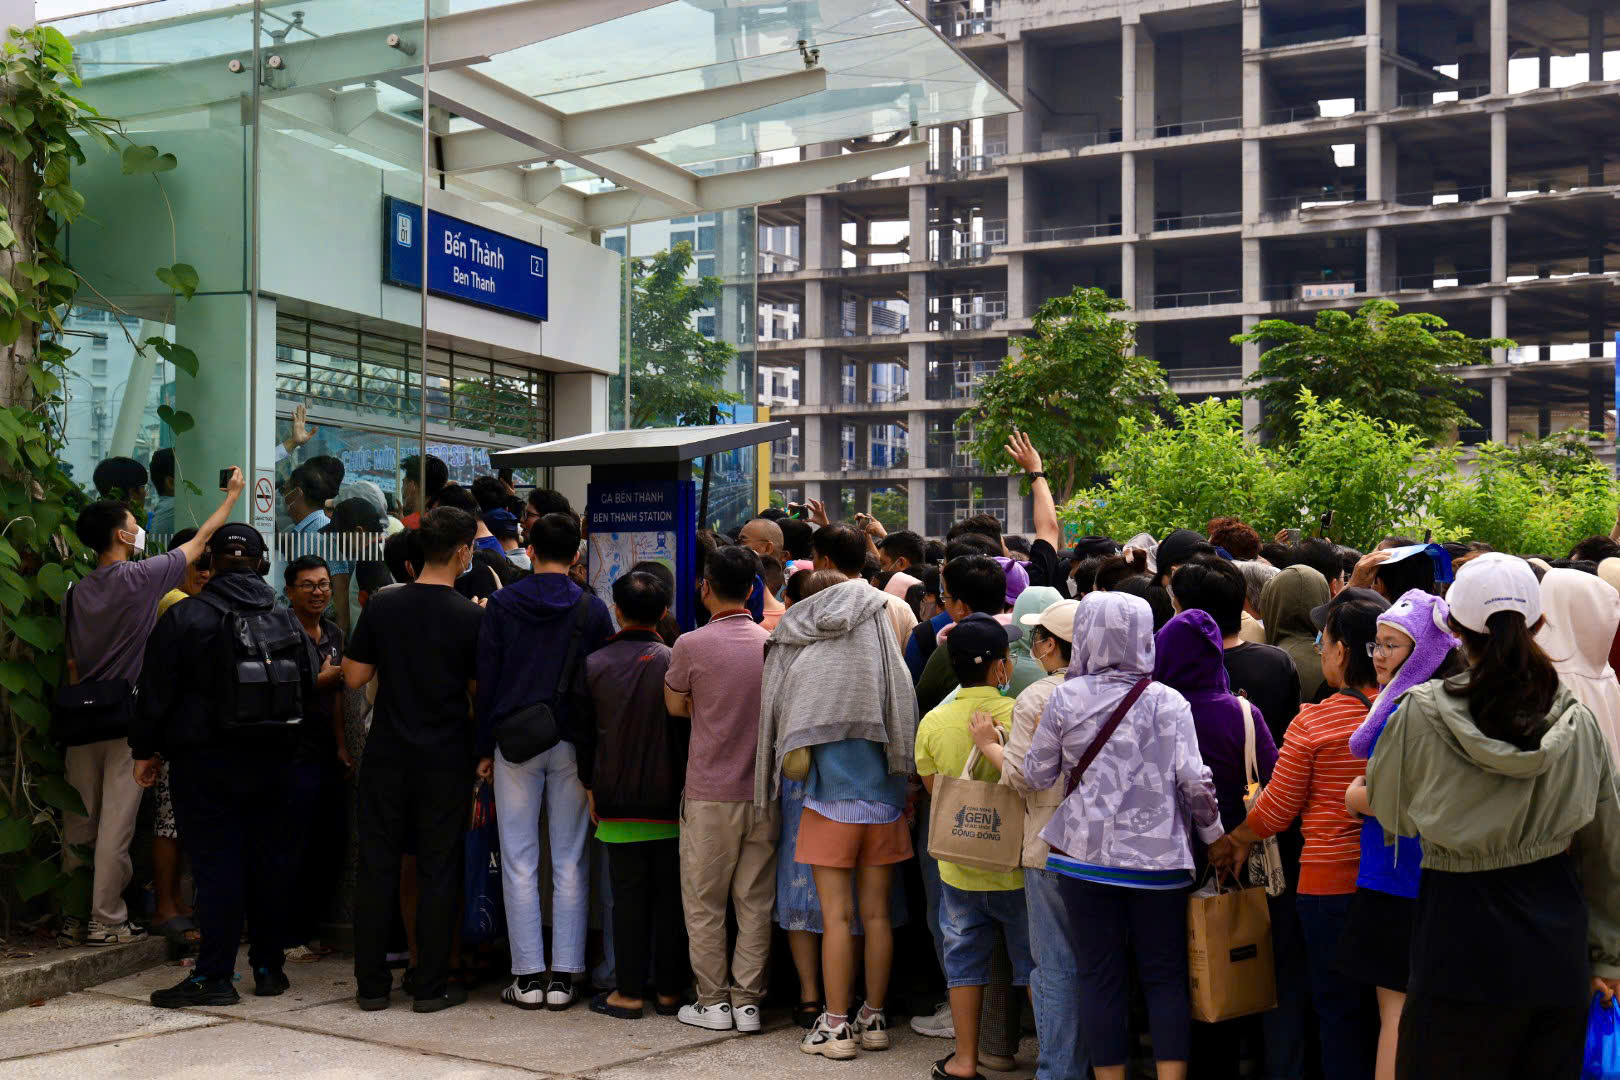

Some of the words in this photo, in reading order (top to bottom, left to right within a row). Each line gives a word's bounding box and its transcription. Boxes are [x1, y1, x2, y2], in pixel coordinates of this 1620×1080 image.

[444, 230, 467, 260] Bến
[469, 237, 505, 271] Thành
[453, 266, 469, 286] Ben
[470, 271, 496, 293] Thanh
[601, 493, 613, 504] GA
[593, 512, 609, 523] BEN
[610, 512, 638, 523] THANH
[639, 511, 672, 522] STATION
[965, 812, 992, 825] GEN
